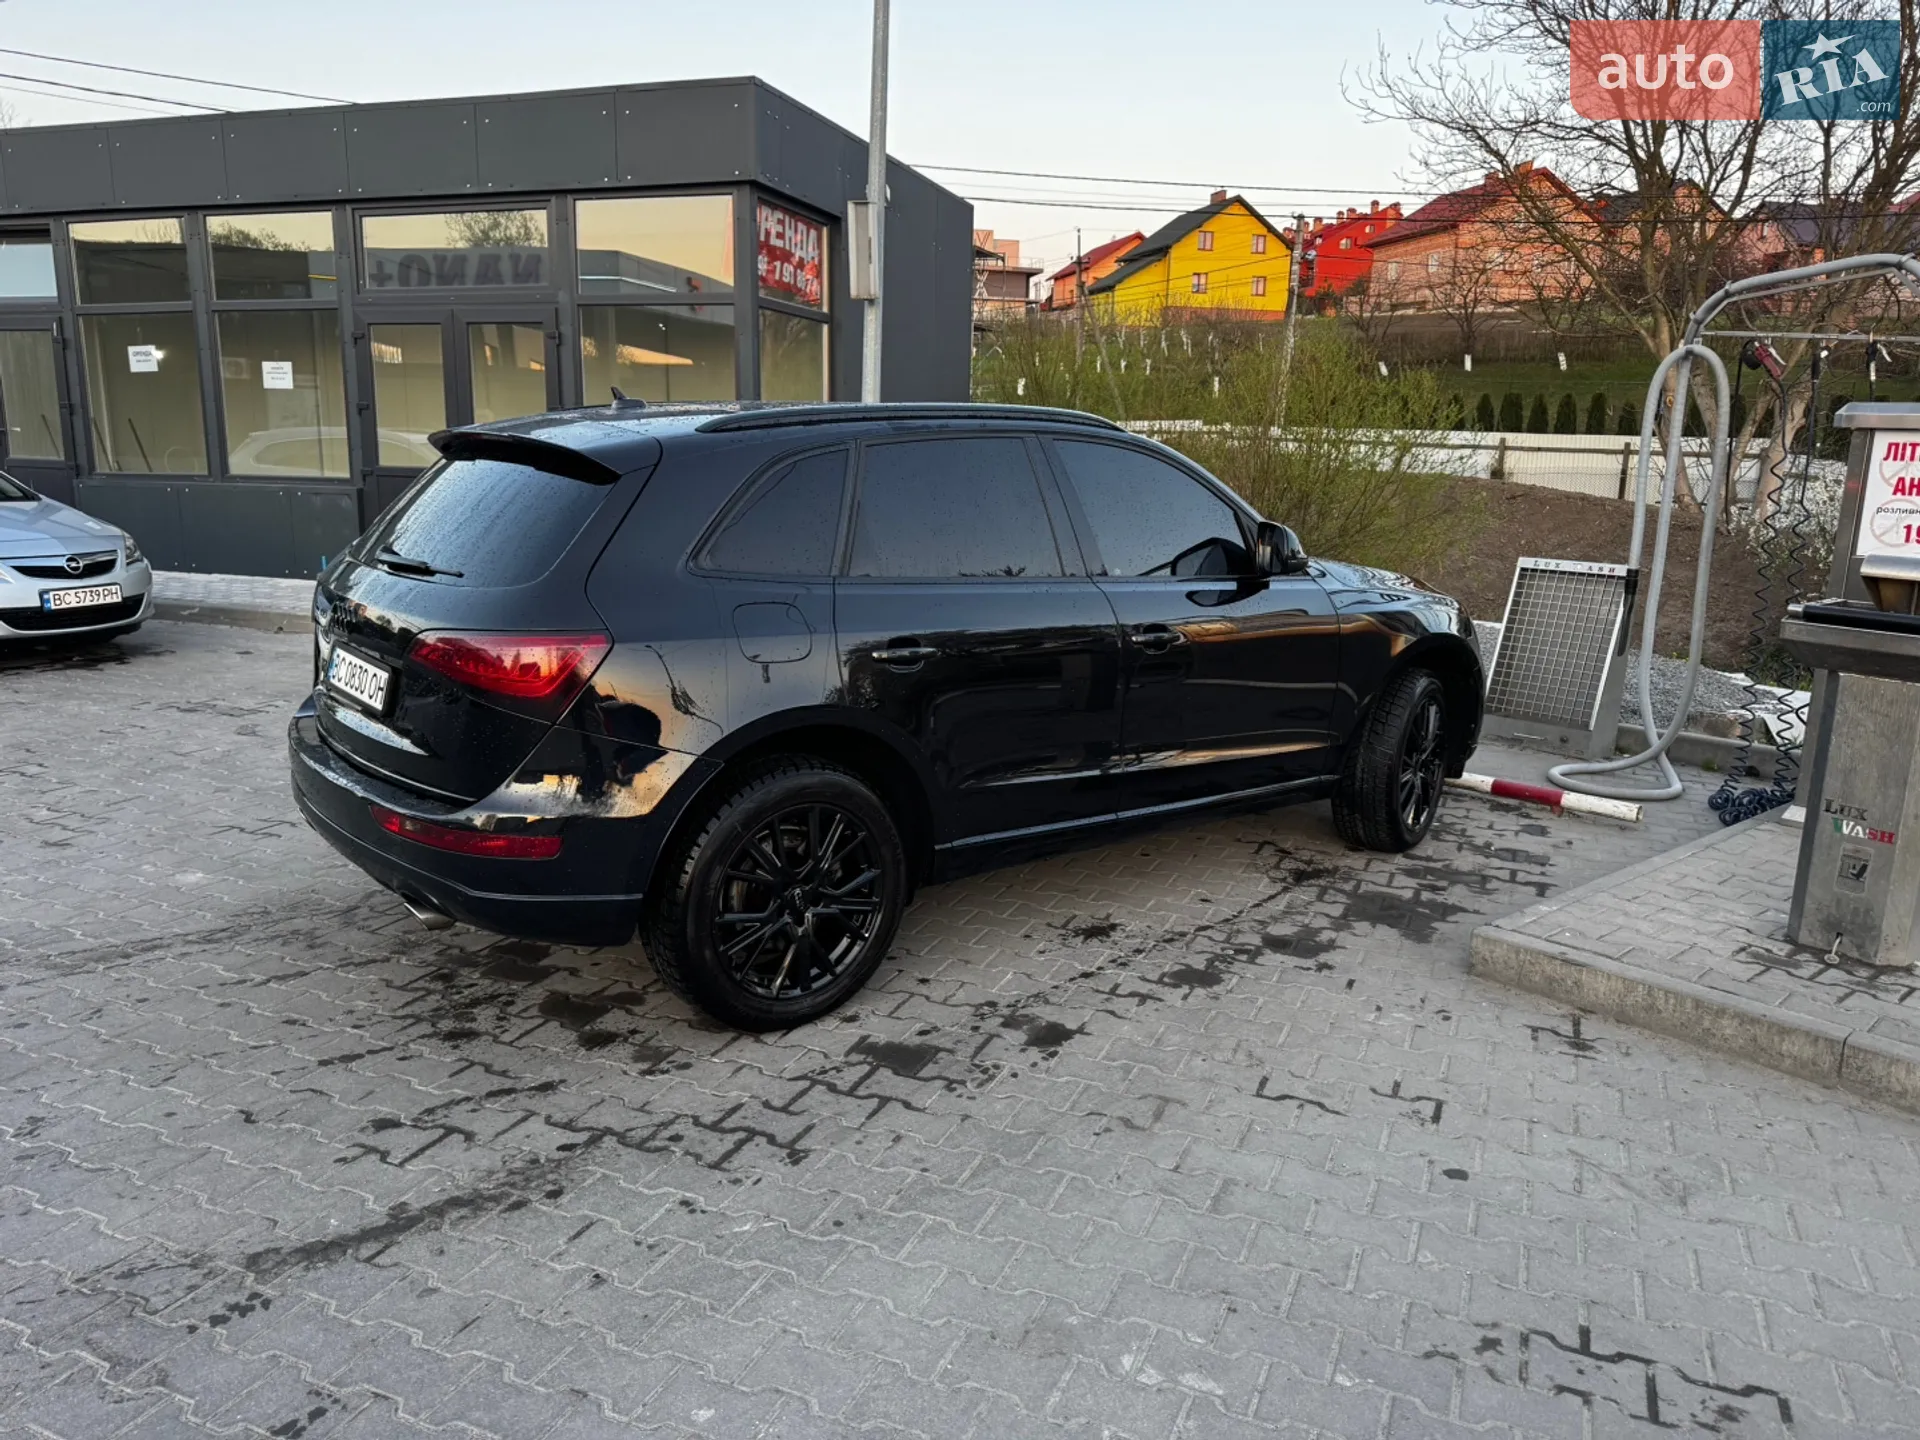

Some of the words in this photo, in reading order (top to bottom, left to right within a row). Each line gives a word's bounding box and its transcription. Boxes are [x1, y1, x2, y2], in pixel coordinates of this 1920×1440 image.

[757, 204, 819, 264] РЕНДА
[1883, 441, 1920, 463] ЛІТ
[52, 593, 72, 607] BC
[74, 589, 101, 604] 5739
[102, 586, 119, 601] PH
[344, 660, 369, 695] 0830
[368, 672, 388, 705] OH
[1823, 798, 1868, 821] LUX
[1831, 817, 1895, 844] WASH
